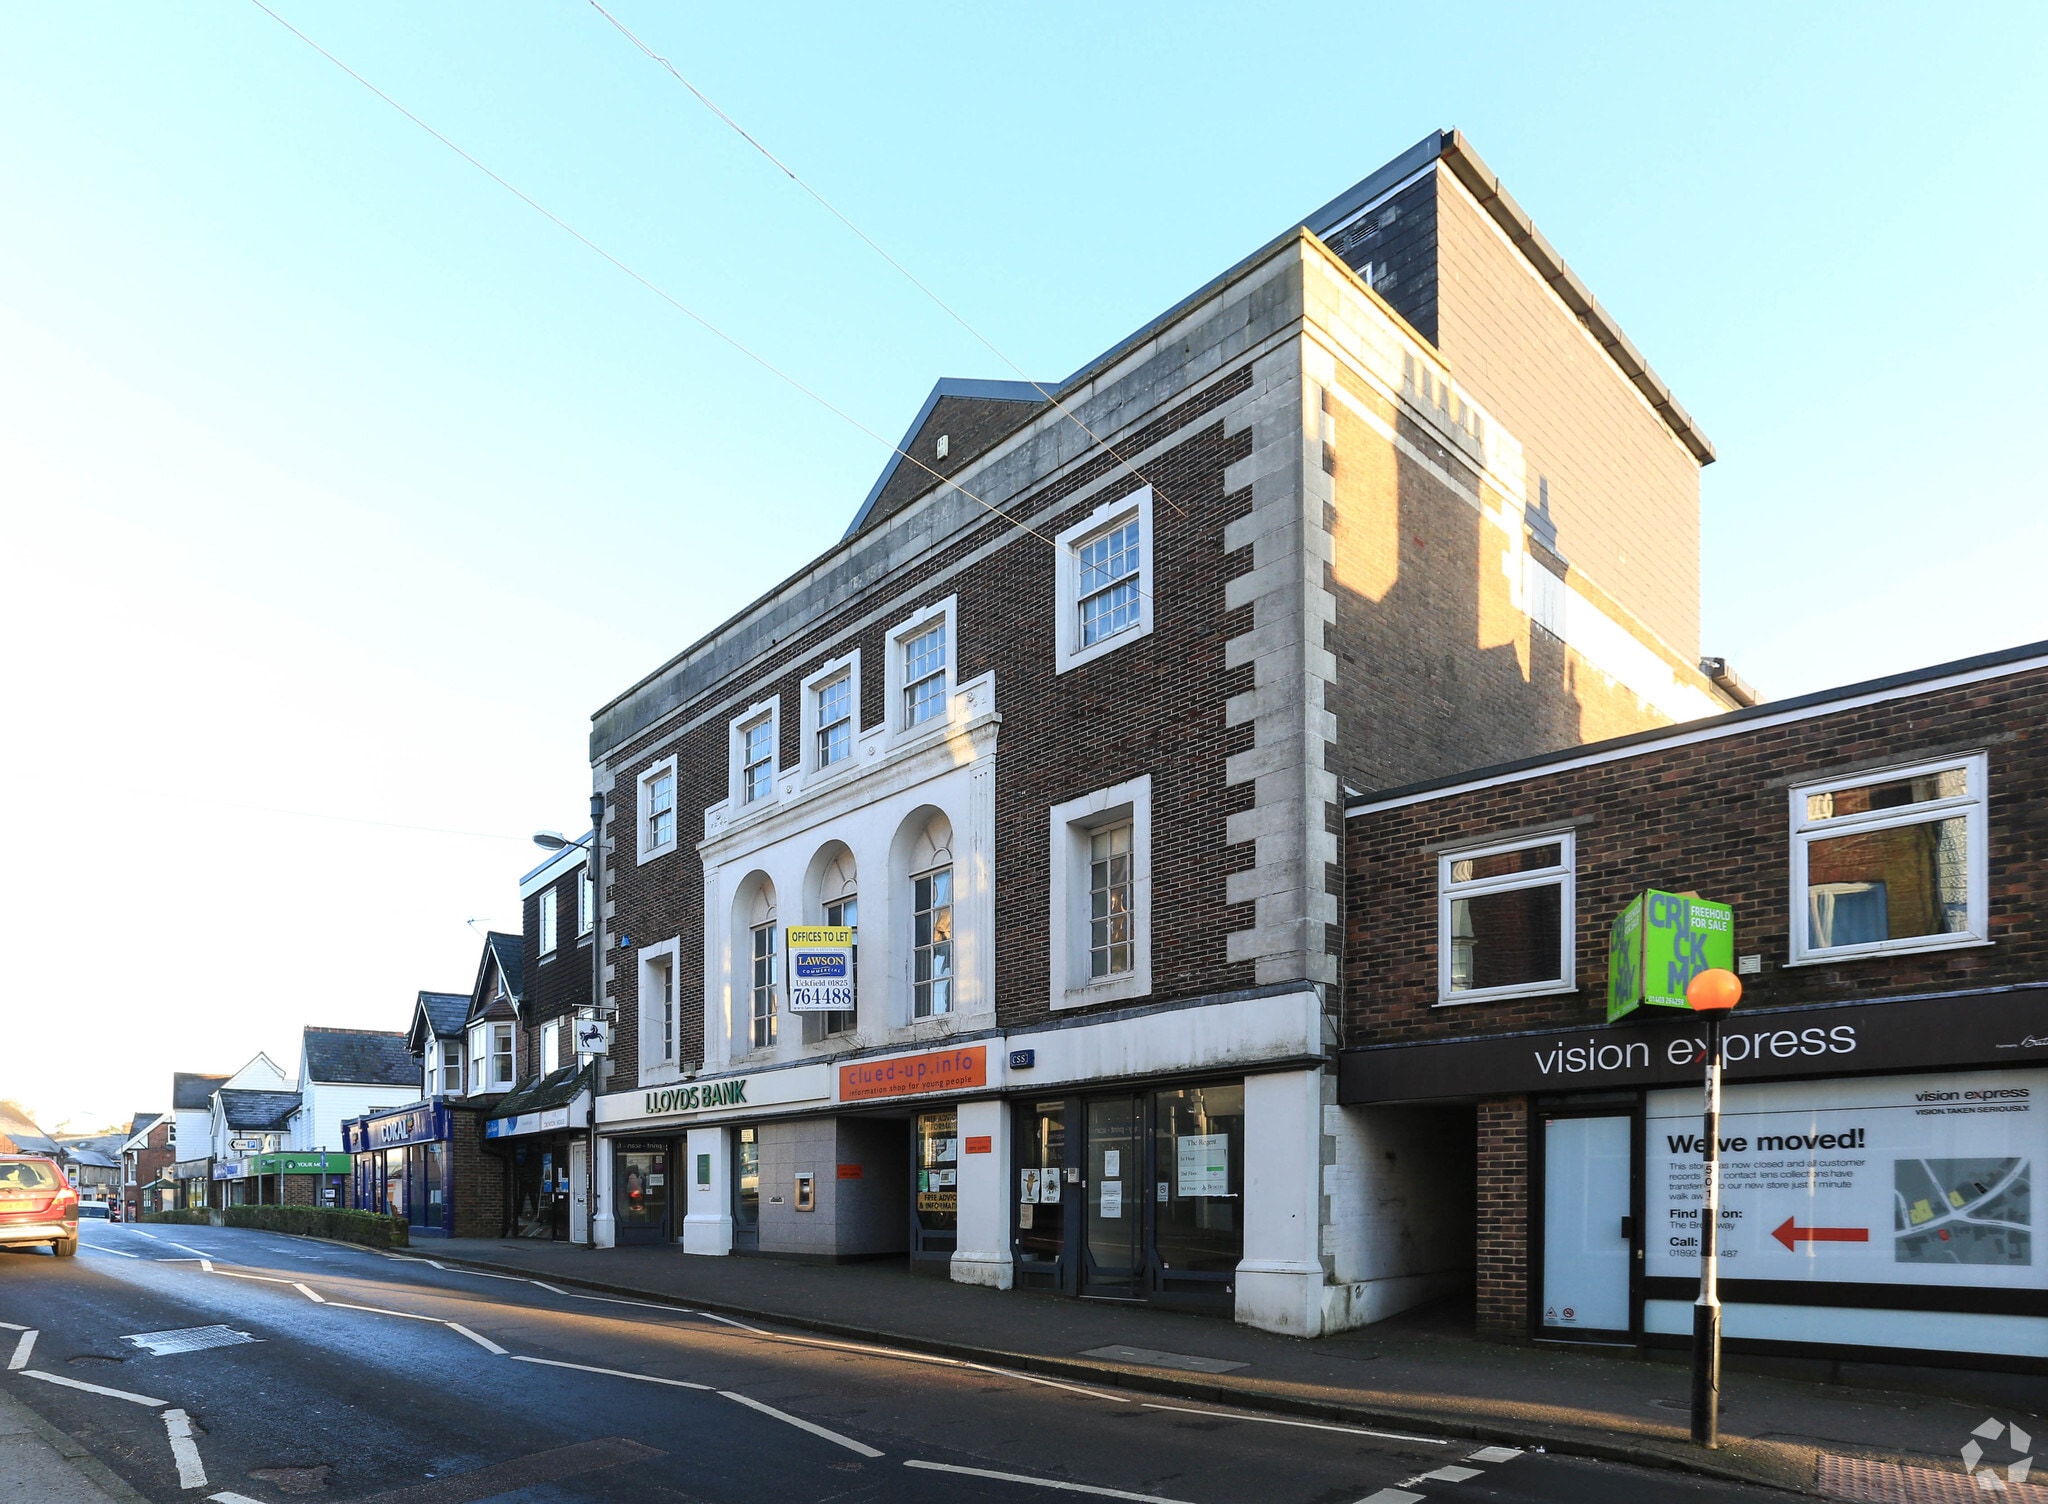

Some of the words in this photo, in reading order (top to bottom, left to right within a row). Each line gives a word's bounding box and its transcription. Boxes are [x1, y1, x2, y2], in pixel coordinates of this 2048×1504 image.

[1691, 906, 1731, 920] FREEHOLD
[1691, 918, 1707, 929] FOR
[1708, 920, 1727, 932] SALE
[792, 932, 822, 942] OFFICES
[823, 932, 834, 942] TO
[836, 932, 849, 942] LET
[798, 956, 844, 966] LAWSON
[793, 988, 851, 1005] 764488
[1012, 1055, 1026, 1064] CSS
[1534, 1038, 1649, 1074] vision
[849, 1052, 973, 1085] clued-up.info
[849, 1086, 887, 1097] information
[889, 1084, 906, 1094] shop
[908, 1082, 918, 1090] for
[921, 1080, 944, 1090] young
[946, 1076, 972, 1087] people
[646, 1087, 699, 1114] LLOYDS
[701, 1079, 747, 1108] BANK
[1915, 1090, 1959, 1102] vision
[1964, 1088, 2030, 1101] express
[938, 1113, 956, 1121] ADVIC
[381, 1119, 408, 1143] CORAL
[1198, 1139, 1217, 1147] Regent
[1667, 1134, 1748, 1154] Weve
[1757, 1128, 1865, 1151] moved!
[1689, 1162, 1704, 1170] stor
[1754, 1161, 1784, 1169] closed
[1830, 1170, 1853, 1178] have
[1792, 1181, 1808, 1190] just
[939, 1194, 957, 1202] ADVIC
[1670, 1209, 1698, 1218] Find
[1722, 1210, 1743, 1219] on:
[1670, 1221, 1687, 1229] The
[1690, 1221, 1736, 1232] Broway
[1670, 1237, 1698, 1247] Call:
